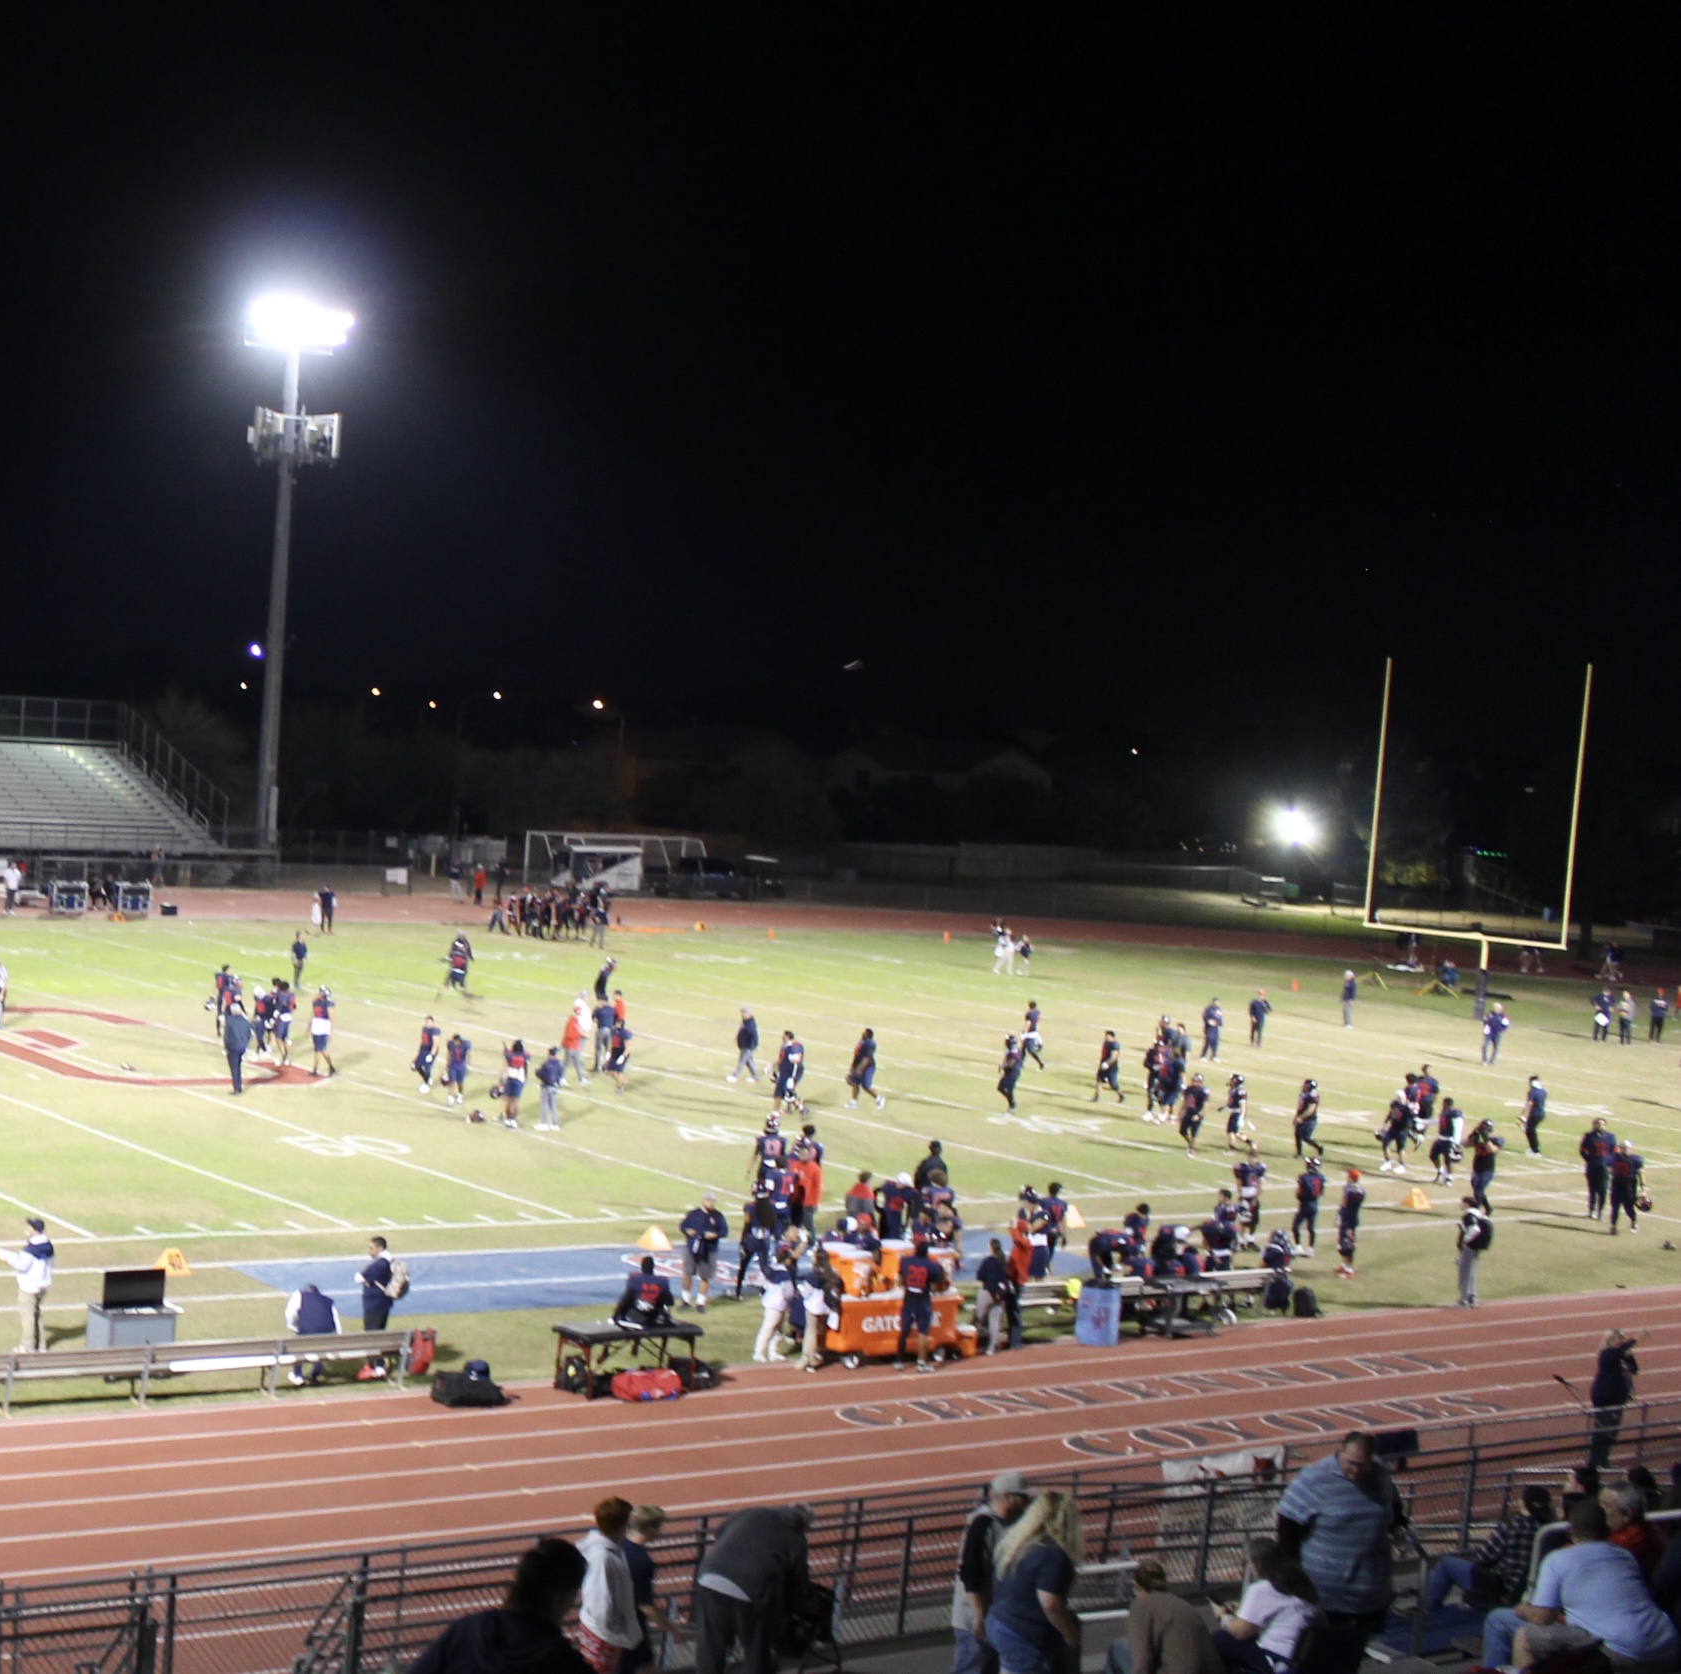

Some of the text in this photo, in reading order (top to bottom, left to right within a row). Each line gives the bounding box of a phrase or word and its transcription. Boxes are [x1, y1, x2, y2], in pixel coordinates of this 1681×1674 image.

[167, 1253, 183, 1271] 40
[834, 1351, 1467, 1428] CENTENNIAL
[1061, 1393, 1505, 1457] COYOTES
